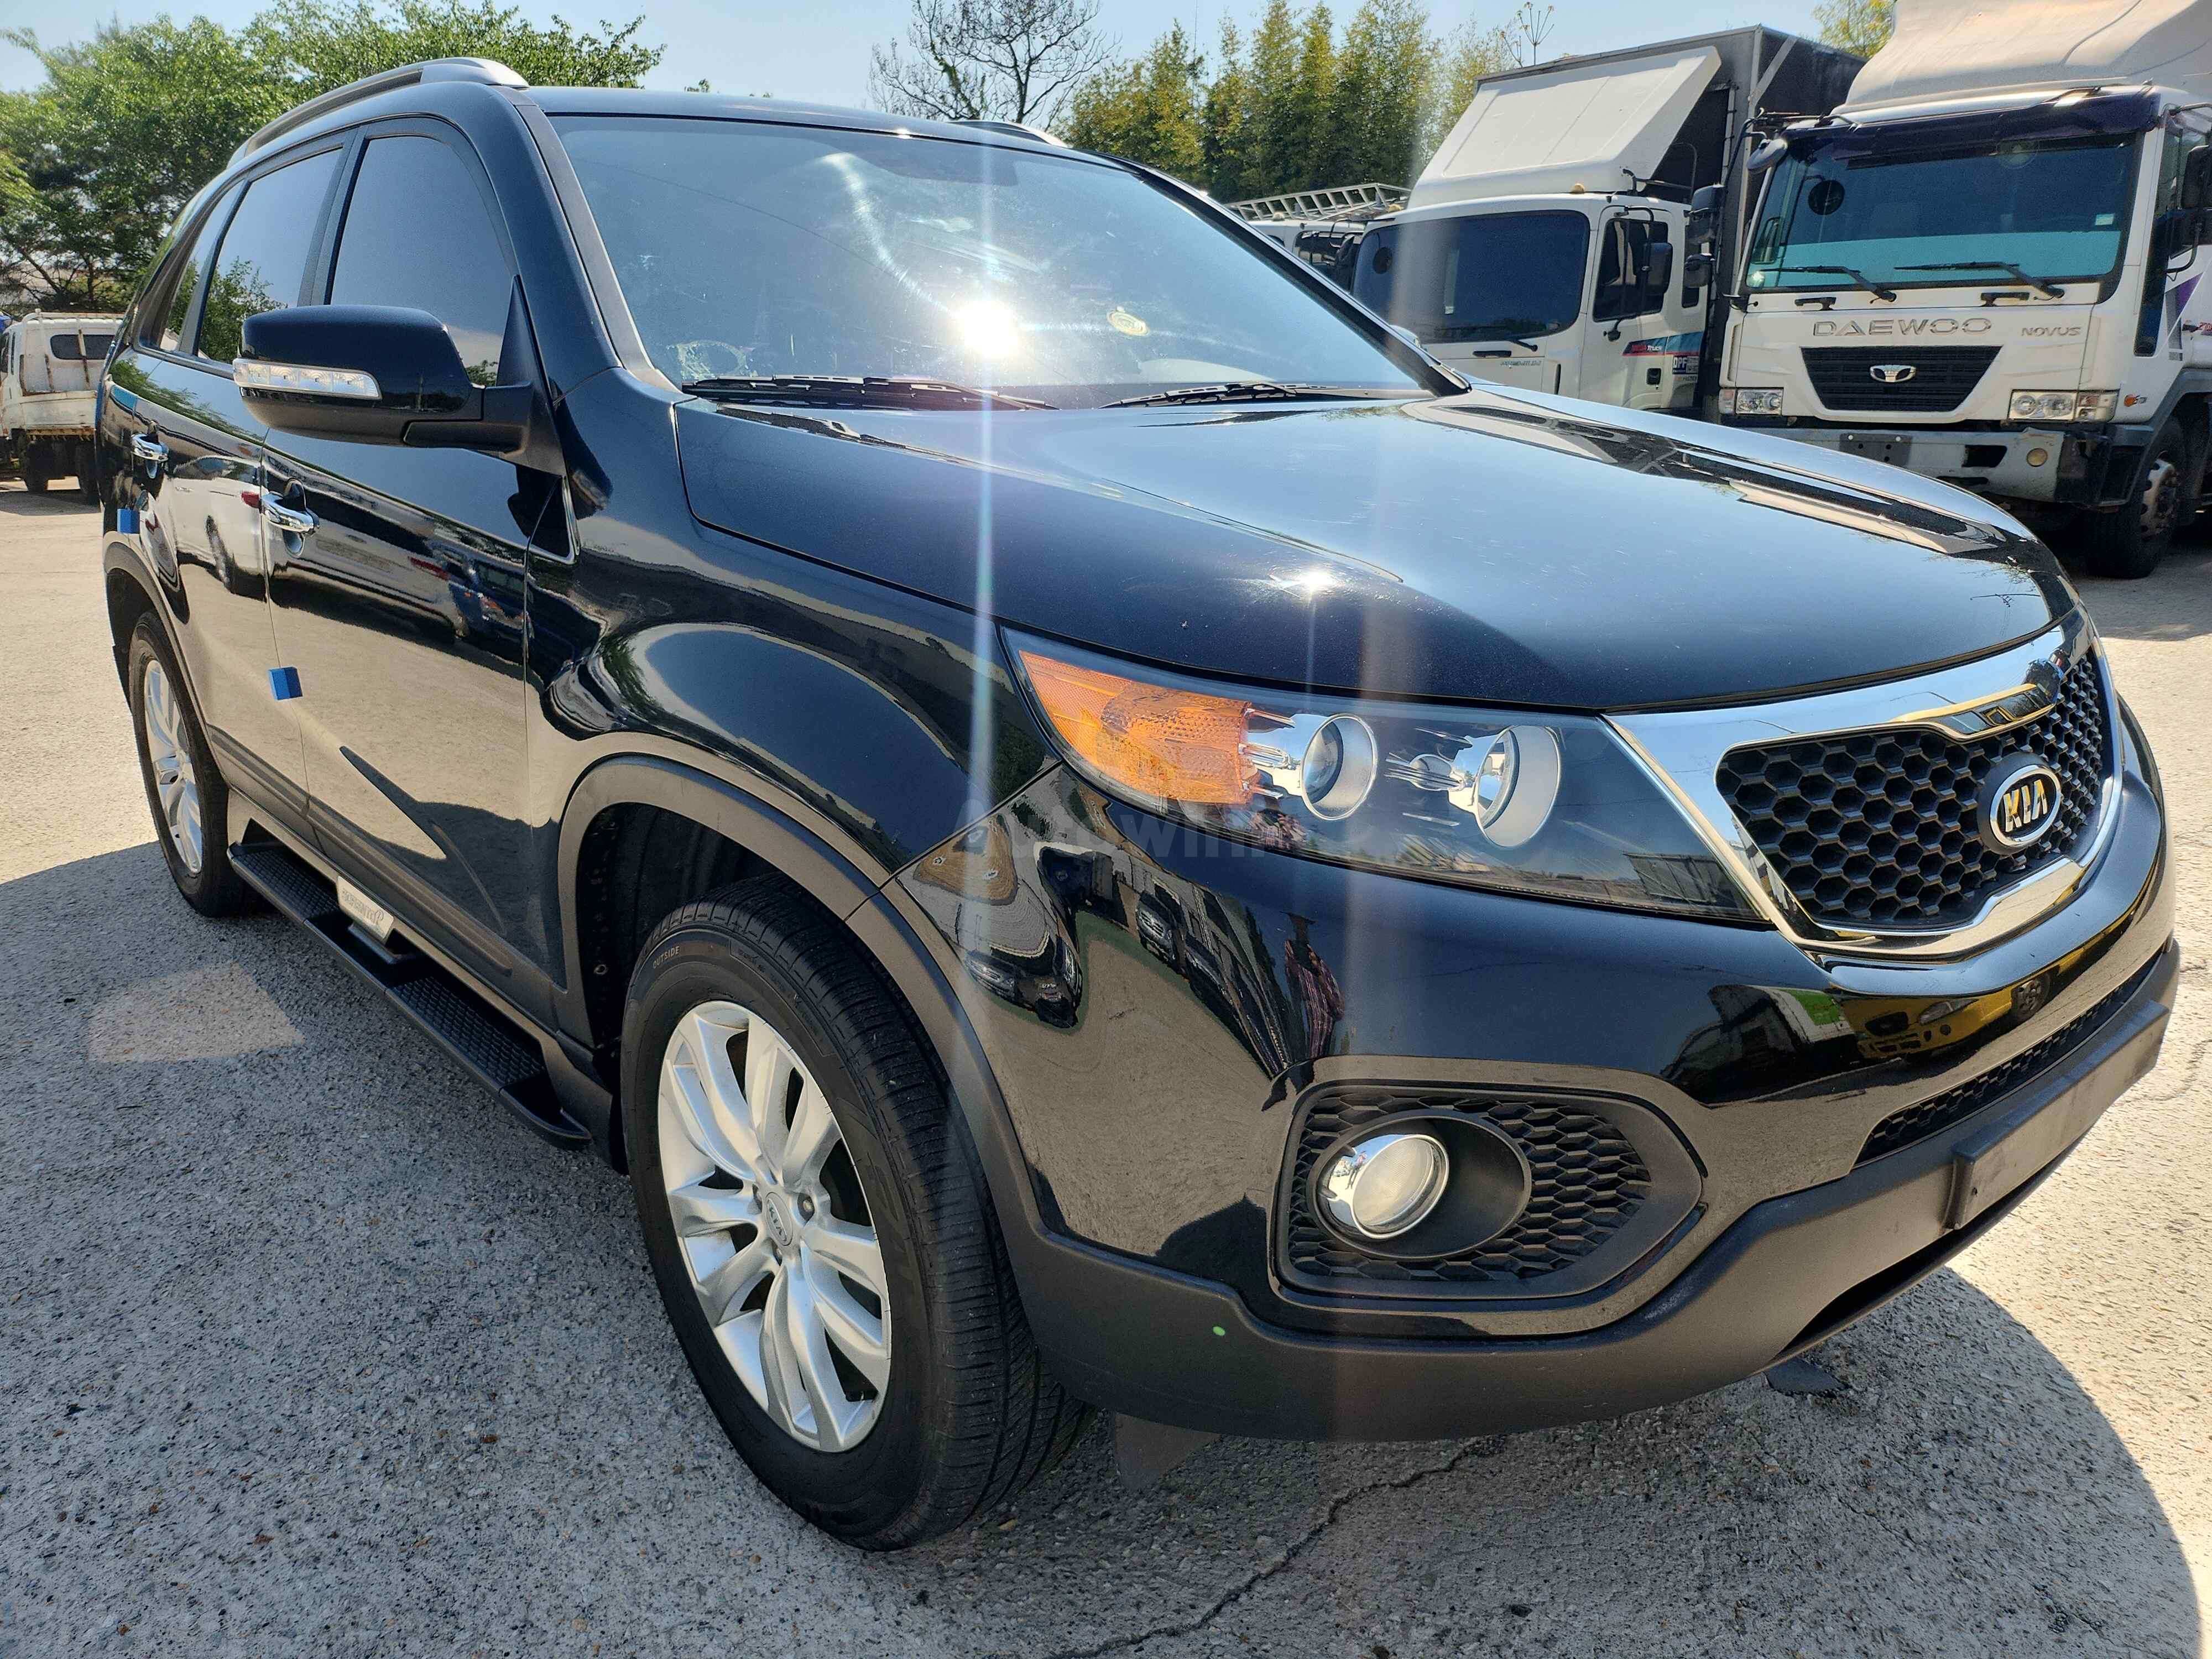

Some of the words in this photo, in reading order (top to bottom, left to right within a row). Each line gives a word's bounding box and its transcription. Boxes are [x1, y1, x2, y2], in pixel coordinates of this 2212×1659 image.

[1813, 317, 1992, 337] DAEWOO
[2021, 327, 2081, 337] NOVUS
[2002, 779, 2048, 832] KIA
[653, 946, 680, 969] OUTSIDE
